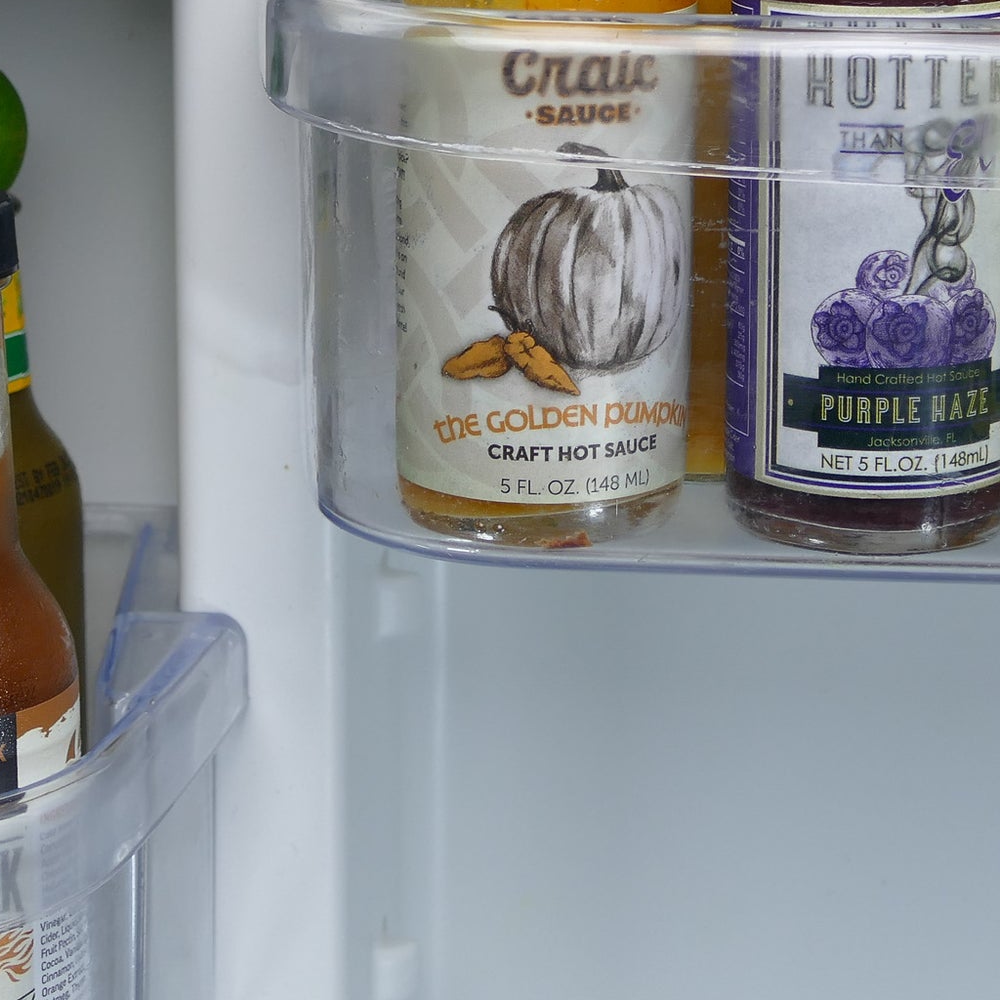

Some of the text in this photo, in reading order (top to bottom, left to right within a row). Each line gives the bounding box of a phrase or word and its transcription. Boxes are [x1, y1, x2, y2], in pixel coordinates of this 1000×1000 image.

[502, 48, 659, 98] Craic
[535, 102, 632, 126] SAUCE
[840, 130, 904, 149] THAN
[836, 367, 980, 385] Hand Crafted Hot Sauce
[486, 403, 598, 434] GOLDEN
[821, 387, 989, 425] PURPLE HAZE
[487, 434, 657, 462] CRAFT HOT SAUCE
[946, 432, 957, 444] FL
[821, 453, 853, 471] NET
[858, 456, 869, 472] 5
[934, 445, 989, 474] (148mL)
[500, 468, 650, 495] 5 FL. OZ. (148 ML)
[40, 944, 58, 959] Fruit
[41, 979, 67, 998] Orange
